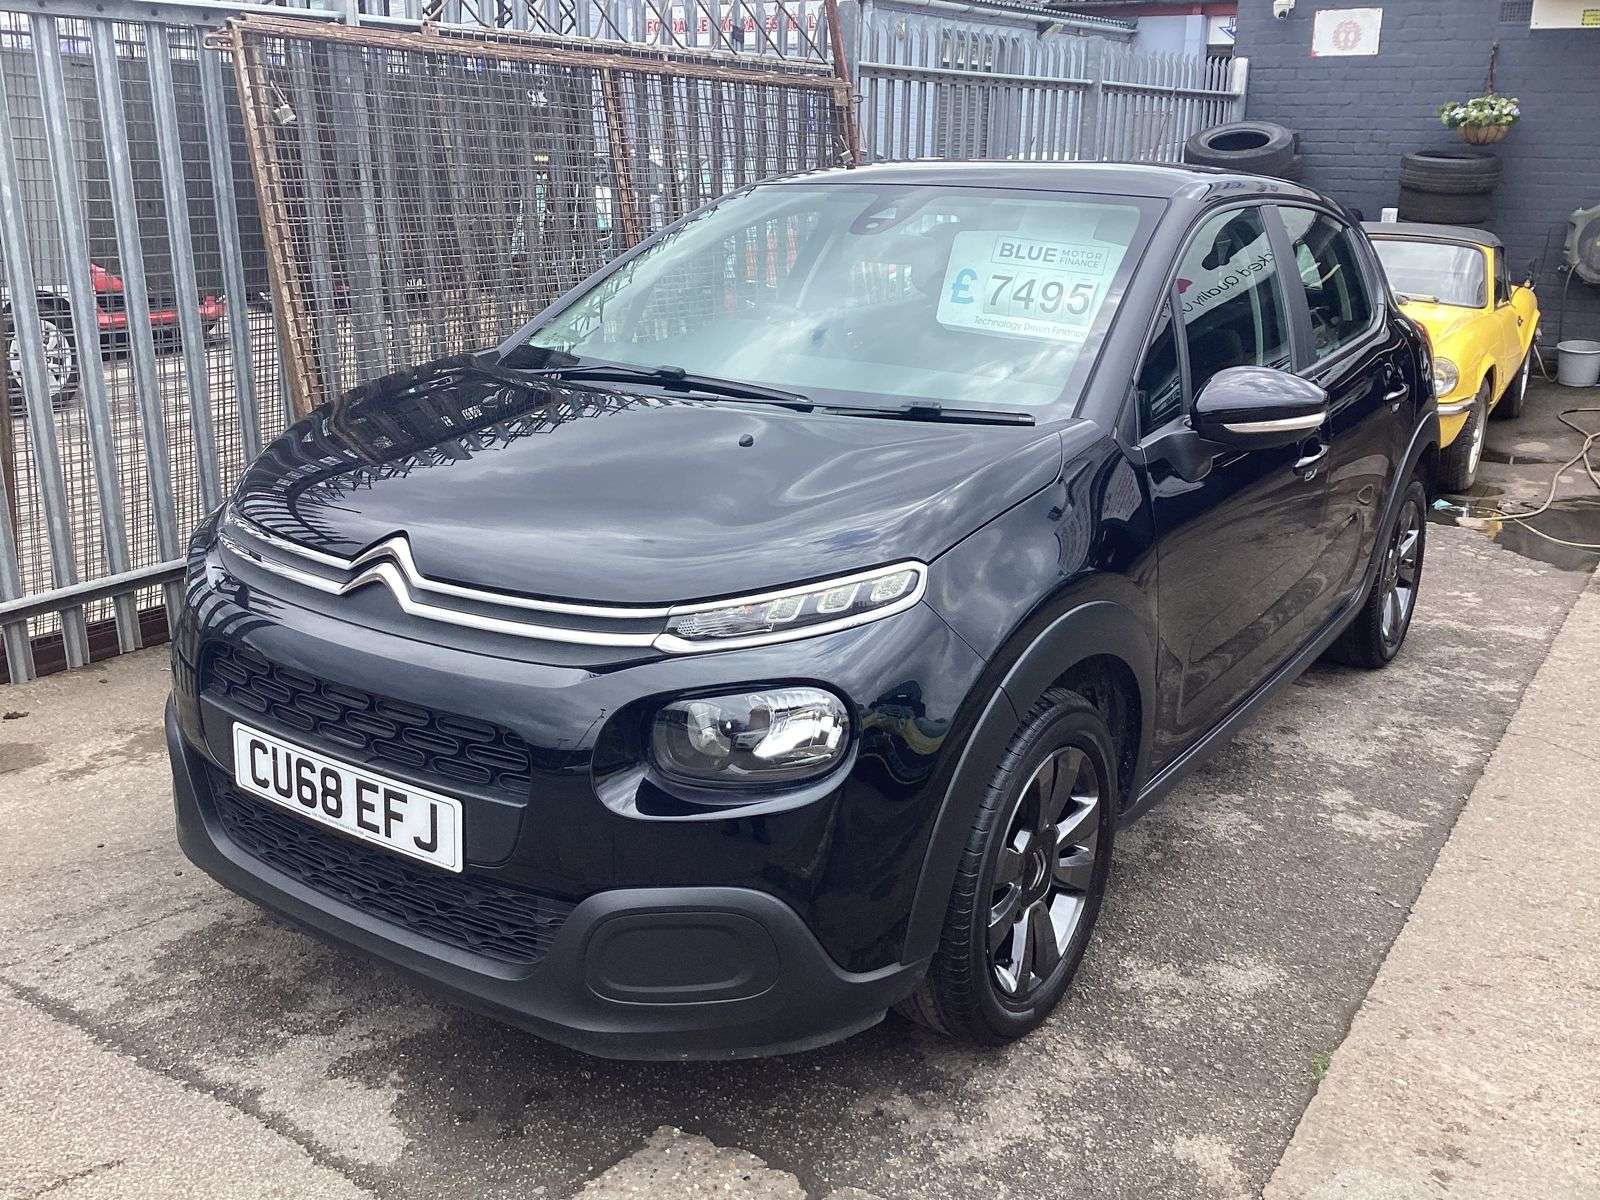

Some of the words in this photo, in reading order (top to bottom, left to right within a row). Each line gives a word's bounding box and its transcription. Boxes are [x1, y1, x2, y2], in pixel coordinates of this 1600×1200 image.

[999, 242, 1058, 263] BLUE
[1059, 258, 1100, 269] FINANCE
[1061, 249, 1103, 260] MOTOR
[950, 267, 978, 305] £
[990, 274, 1094, 315] 7495
[975, 315, 1023, 332] Technology
[1023, 321, 1051, 334] Driven
[1052, 326, 1088, 338] Finance
[249, 738, 343, 819] CU68
[355, 778, 438, 853] EFJ
